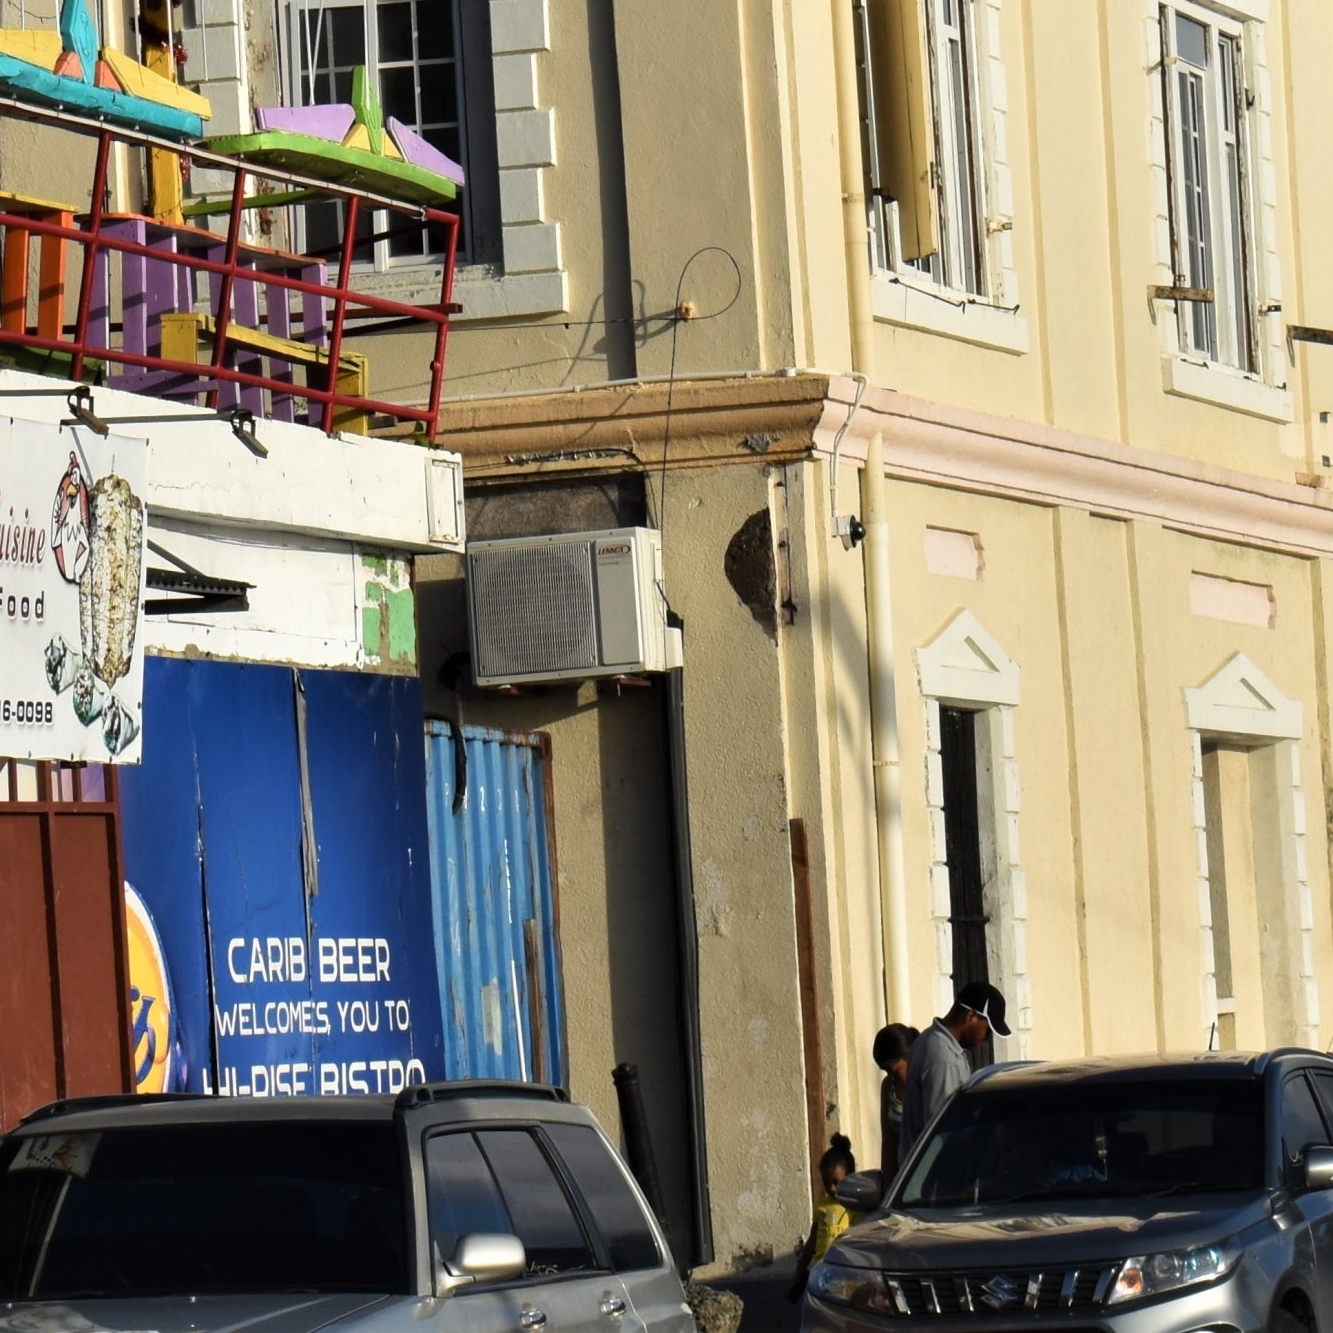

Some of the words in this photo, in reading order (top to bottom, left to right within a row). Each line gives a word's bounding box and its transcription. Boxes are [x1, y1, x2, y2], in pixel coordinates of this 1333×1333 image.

[228, 937, 305, 983] CARIB
[319, 937, 391, 983] BEER
[337, 1000, 380, 1033] YOU
[384, 1000, 410, 1031] TO
